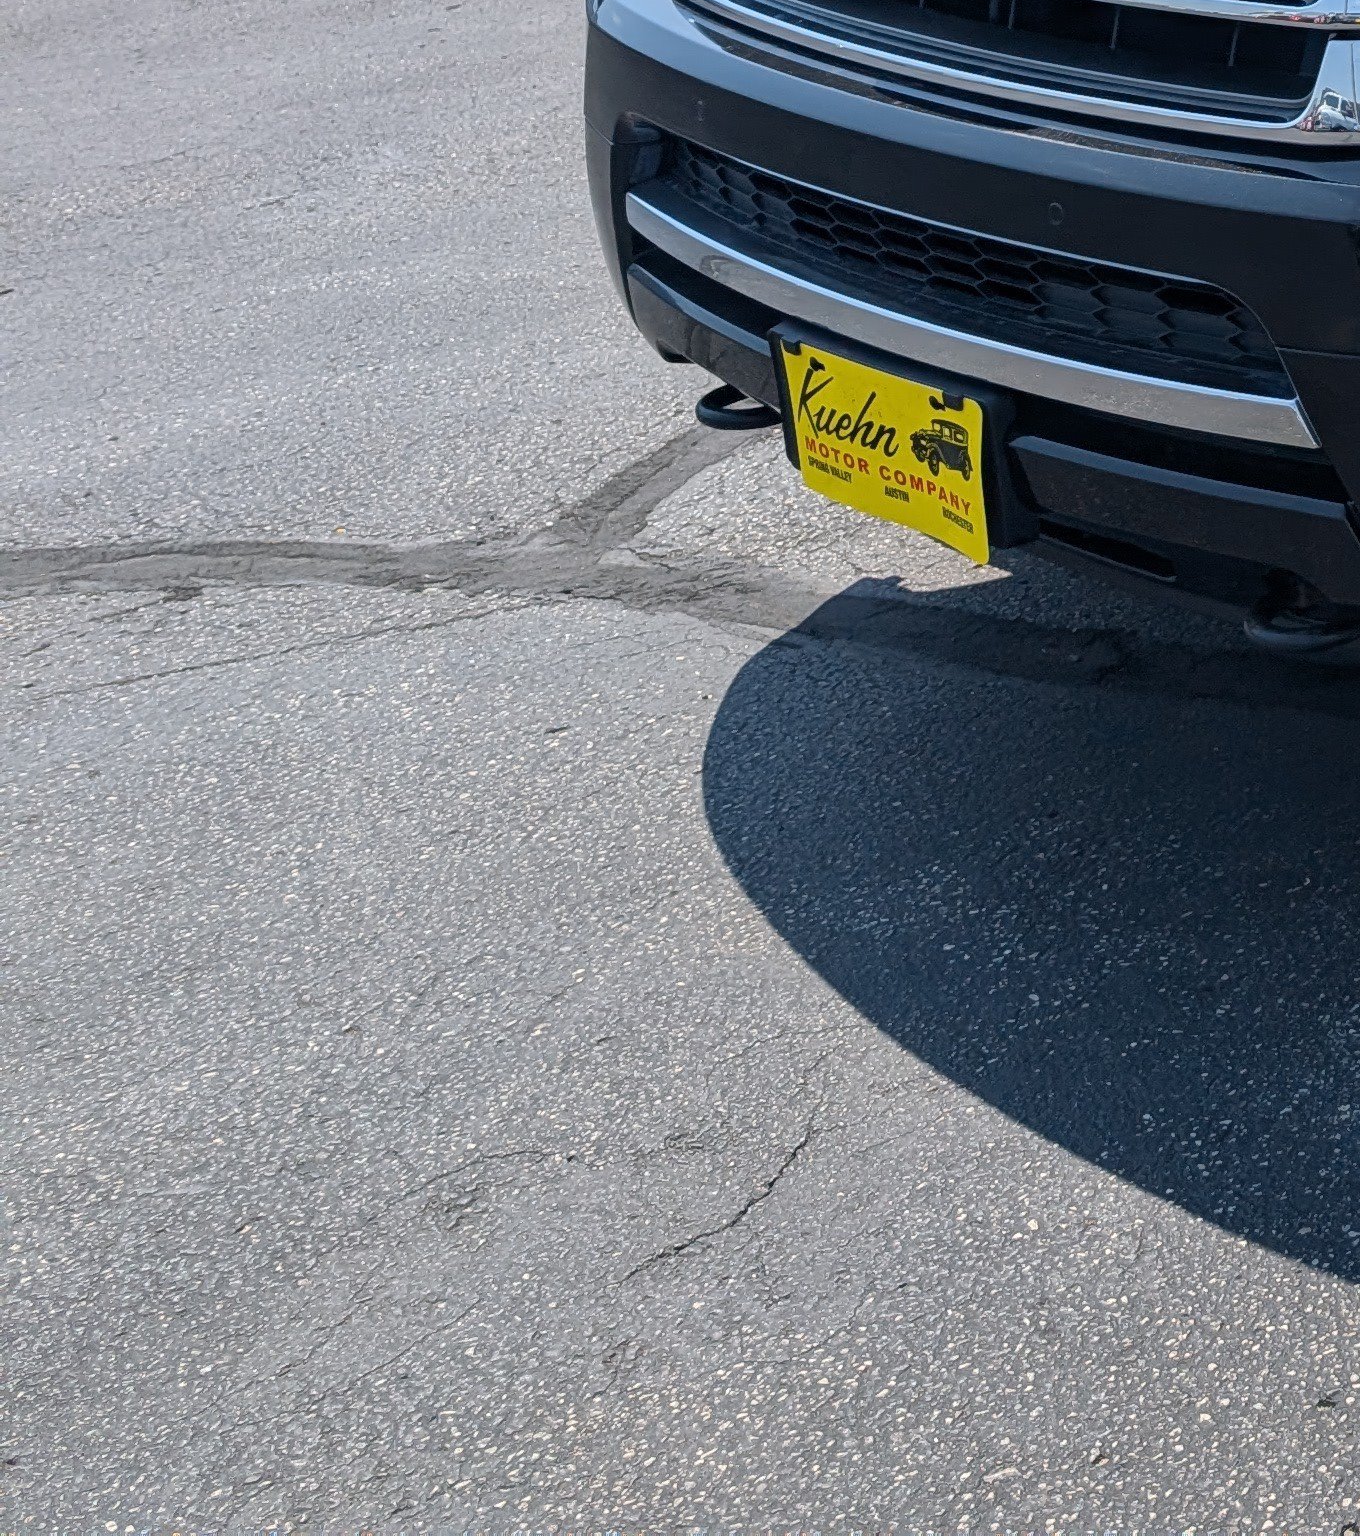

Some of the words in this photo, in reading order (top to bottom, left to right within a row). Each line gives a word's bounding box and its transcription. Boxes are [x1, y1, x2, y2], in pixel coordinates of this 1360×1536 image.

[798, 367, 900, 457] Kuehn
[805, 436, 871, 475] MOTOR
[879, 465, 972, 516] COMPANY
[884, 485, 910, 503] AUSTIN
